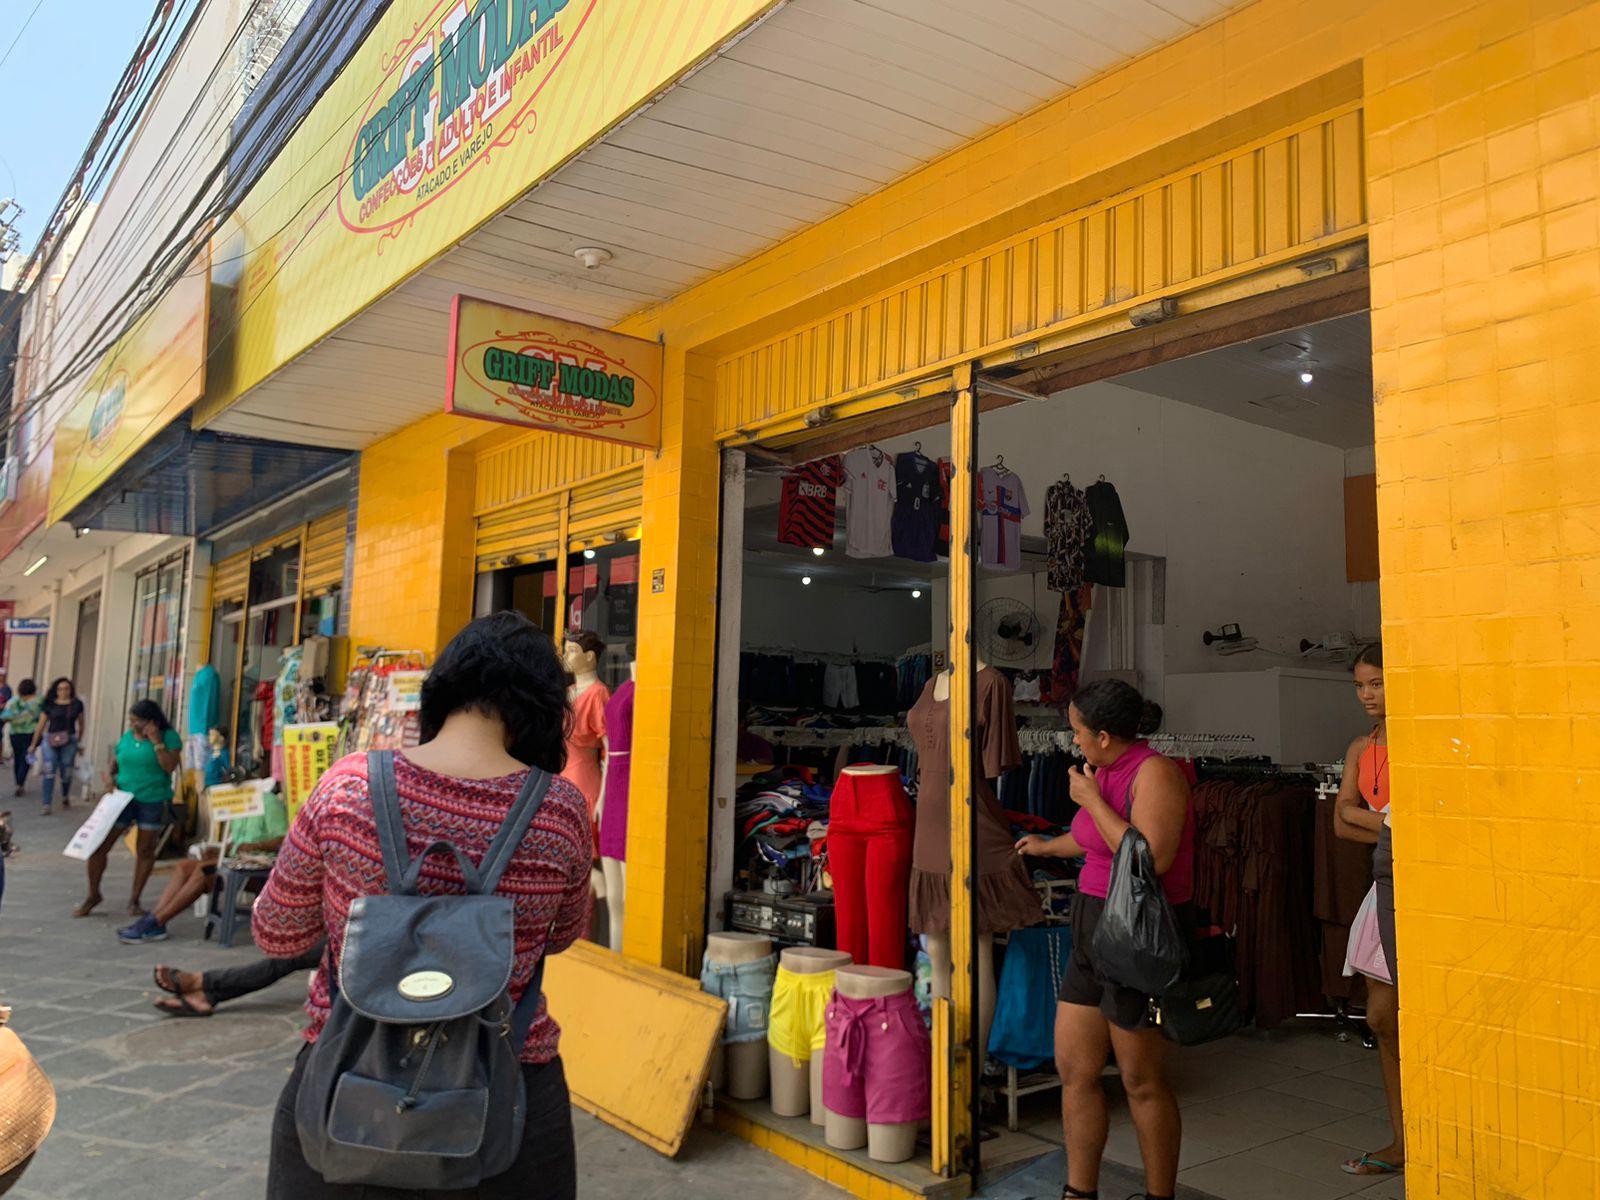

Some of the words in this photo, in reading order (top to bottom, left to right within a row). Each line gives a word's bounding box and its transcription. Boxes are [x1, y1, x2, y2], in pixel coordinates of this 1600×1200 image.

[353, 51, 435, 201] GRIFF
[439, 92, 486, 151] ADULTO
[487, 81, 497, 109] E
[499, 22, 564, 98] INFANTIL
[416, 167, 450, 201] ATACADO
[453, 158, 459, 175] E
[460, 122, 493, 167] VAREJO
[484, 347, 557, 391] GRIFF
[558, 362, 635, 408] MODAS
